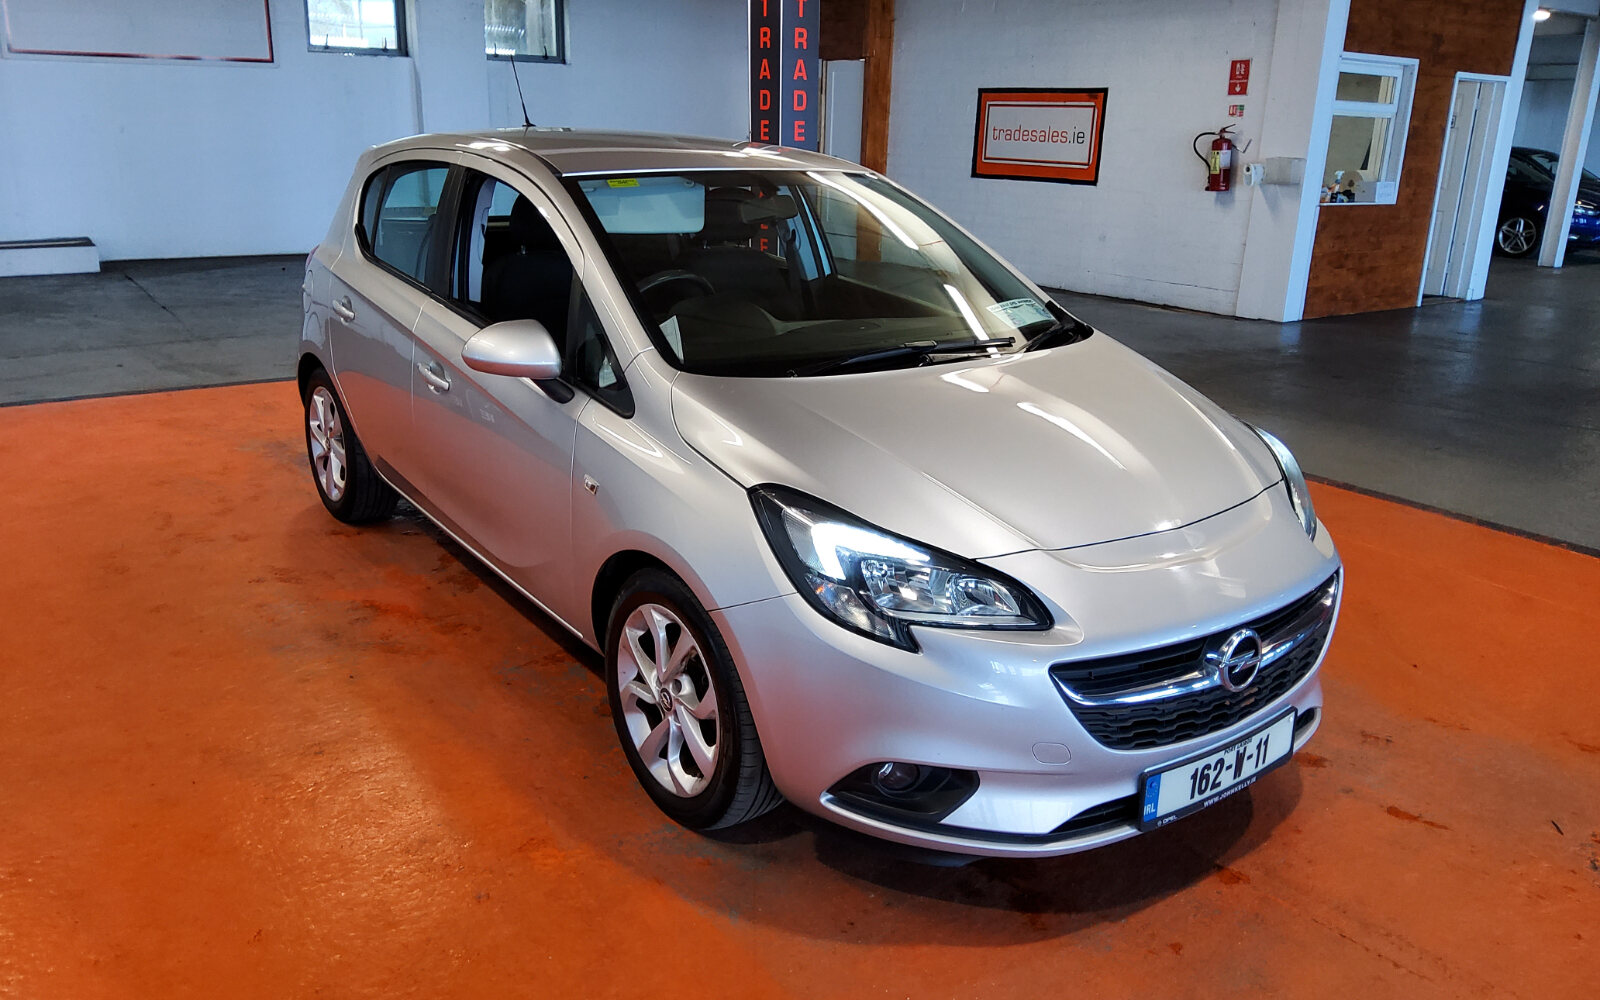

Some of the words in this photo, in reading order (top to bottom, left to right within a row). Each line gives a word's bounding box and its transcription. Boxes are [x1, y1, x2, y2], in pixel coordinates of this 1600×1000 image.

[759, 0, 771, 141] TRADE
[793, 0, 808, 142] TRADE
[992, 124, 1085, 144] tradesales.ie
[1190, 733, 1270, 800] 162-W-11
[1144, 802, 1156, 816] IRL
